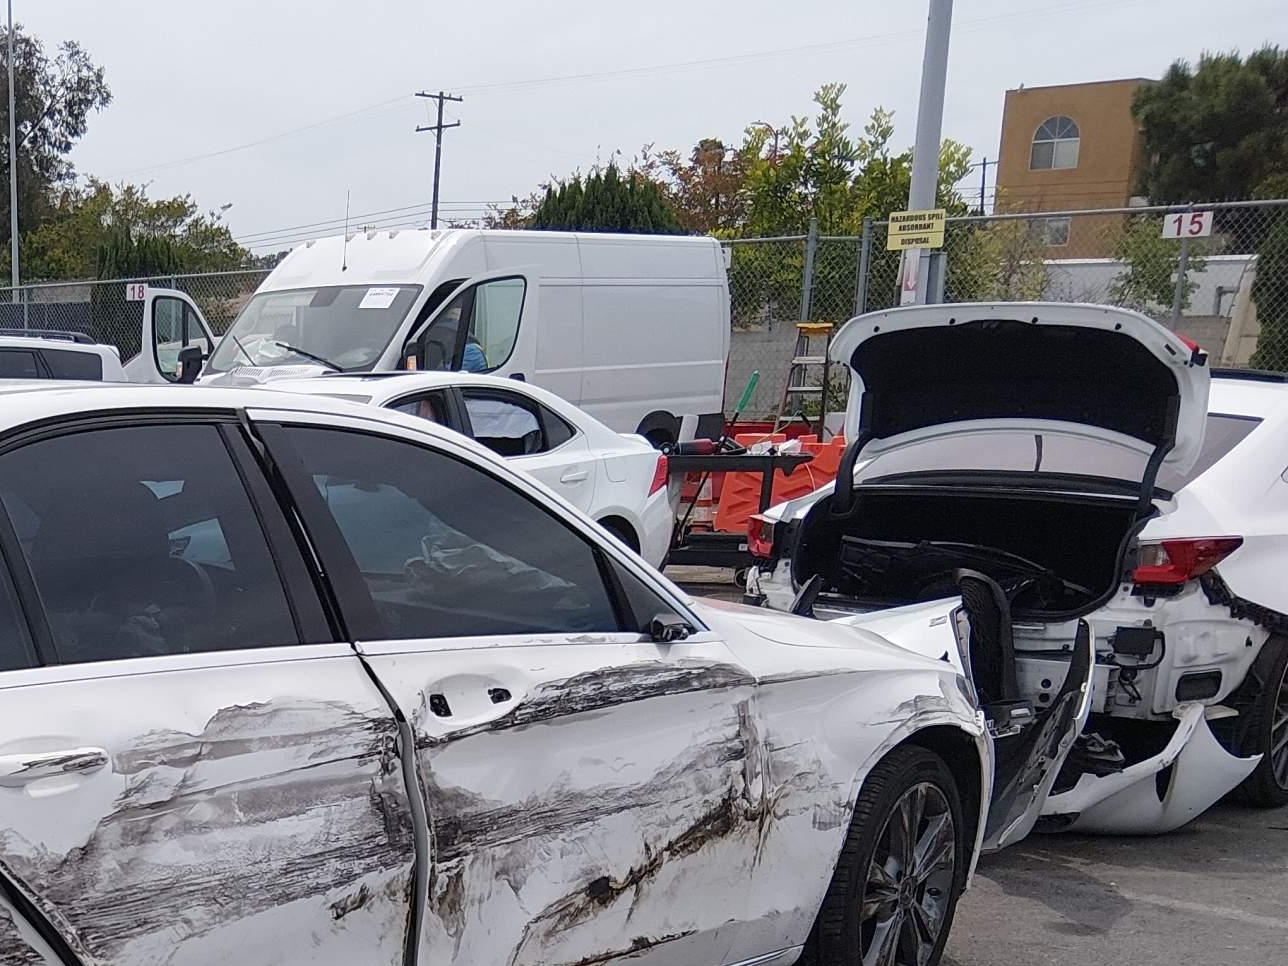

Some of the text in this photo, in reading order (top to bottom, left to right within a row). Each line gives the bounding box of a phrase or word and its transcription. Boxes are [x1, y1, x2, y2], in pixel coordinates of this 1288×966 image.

[890, 213, 943, 223] HAZARDOUS SPILL
[1173, 213, 1204, 236] 15
[900, 237, 929, 245] DISPOSAL
[131, 284, 145, 299] 18
